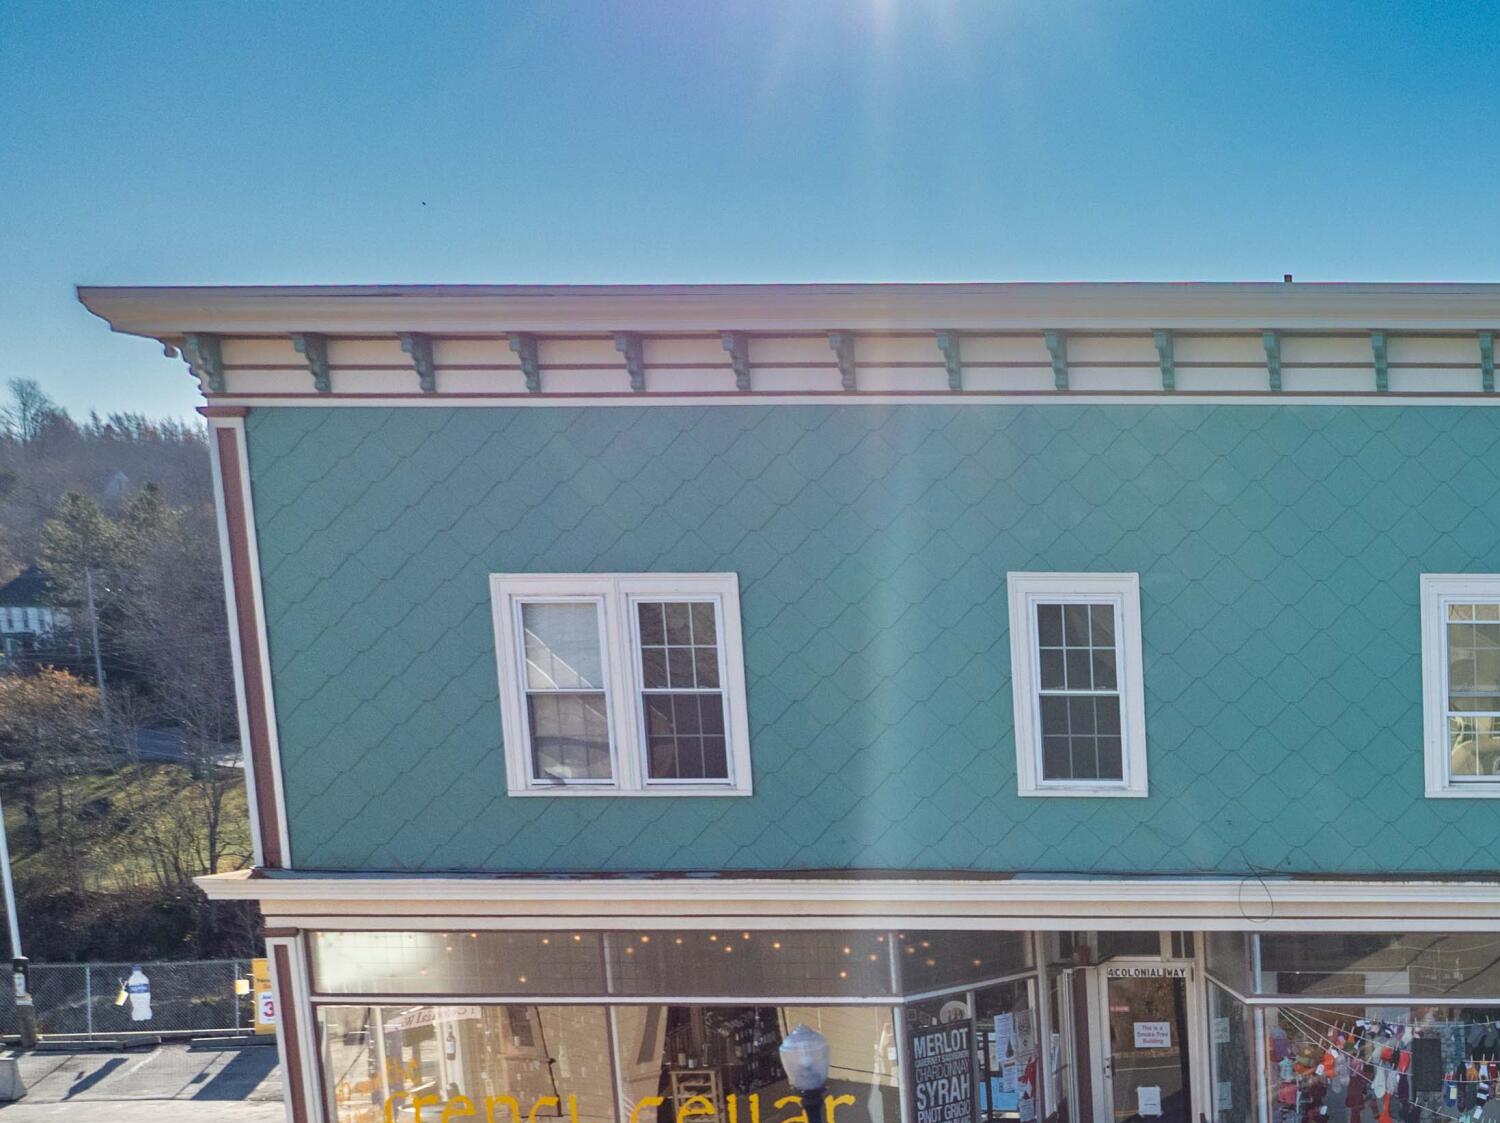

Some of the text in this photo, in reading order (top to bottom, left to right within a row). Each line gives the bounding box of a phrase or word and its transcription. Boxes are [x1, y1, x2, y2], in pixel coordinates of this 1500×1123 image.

[913, 1028, 969, 1059] MERLOT
[915, 1059, 970, 1083] CHARDONNAY
[917, 1073, 970, 1111] SYRAH
[944, 1099, 971, 1120] GRIGIO
